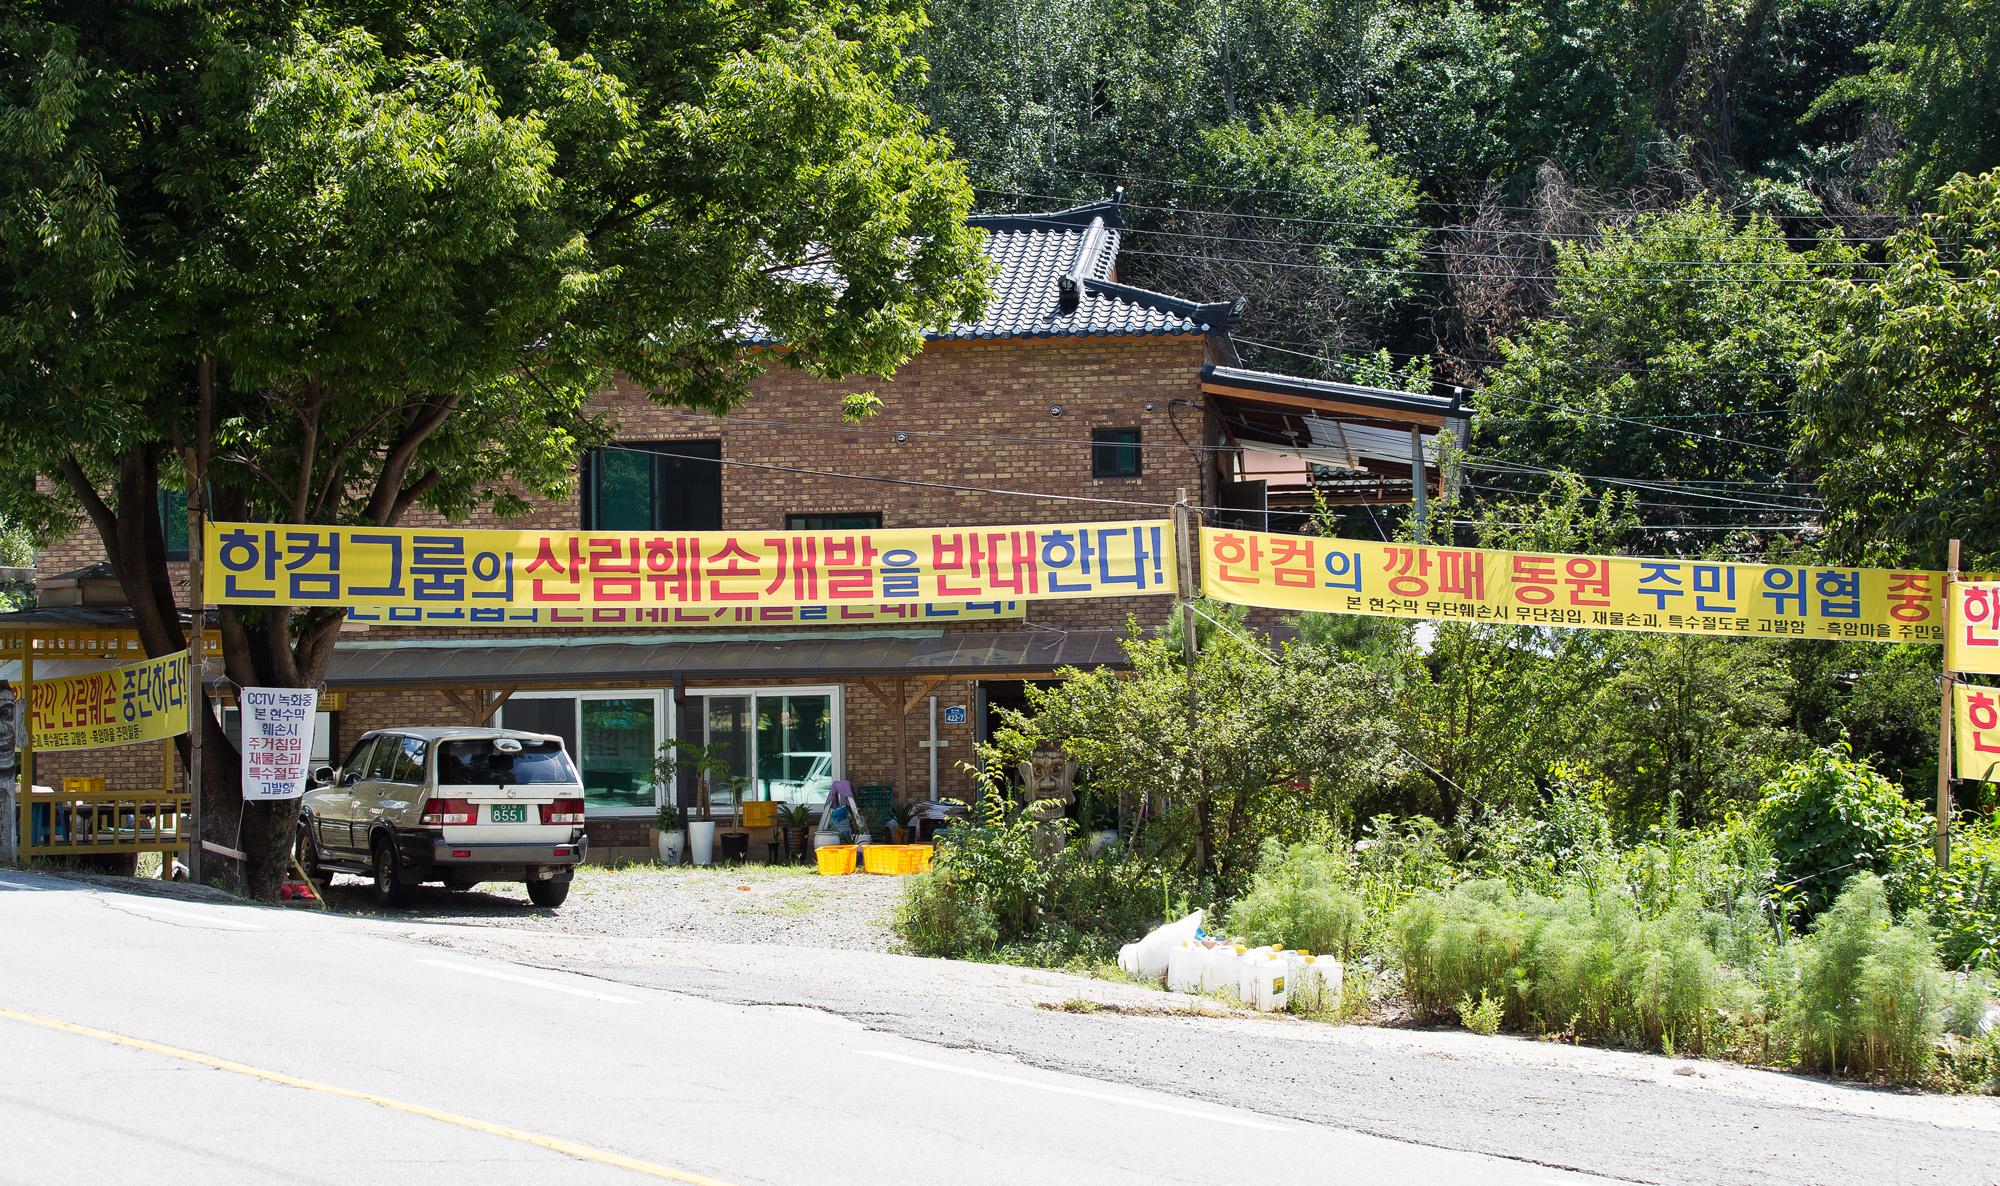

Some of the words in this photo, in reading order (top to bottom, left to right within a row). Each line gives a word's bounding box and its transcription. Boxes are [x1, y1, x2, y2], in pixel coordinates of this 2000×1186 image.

[219, 528, 514, 603] 한컴그룹의
[525, 535, 921, 602] 산림훼손개발을
[931, 526, 1164, 597] 반대한다!
[1213, 533, 1363, 592] 한컴의
[1383, 547, 1485, 601] 깡패
[1510, 556, 1611, 607] 동원
[1637, 562, 1736, 613] 주민
[1762, 567, 1861, 619] 위협
[1346, 595, 1362, 611] 본
[1367, 597, 1419, 615] 현수막
[1425, 601, 1509, 621] 무단훼손시
[1515, 607, 1587, 625] 무단침입,
[1592, 611, 1662, 629] 재물손괴,
[1668, 614, 1750, 632] 특수절도로
[1757, 618, 1806, 635] 고발함
[61, 674, 117, 729] 산림훼손
[122, 656, 188, 723] 중단하라!
[247, 692, 276, 706] CCTV
[278, 693, 313, 707] 녹화중
[254, 707, 267, 721] 본
[269, 707, 306, 722] 현수막
[946, 714, 964, 722] 422-7
[261, 722, 298, 737] 훼손시
[43, 733, 70, 748] 특수절도로
[70, 730, 88, 746] 고발함
[248, 737, 302, 751] 주거침입
[248, 752, 302, 766] 재물손괴
[260, 782, 296, 795] 고발함!
[493, 810, 523, 821] 8551
